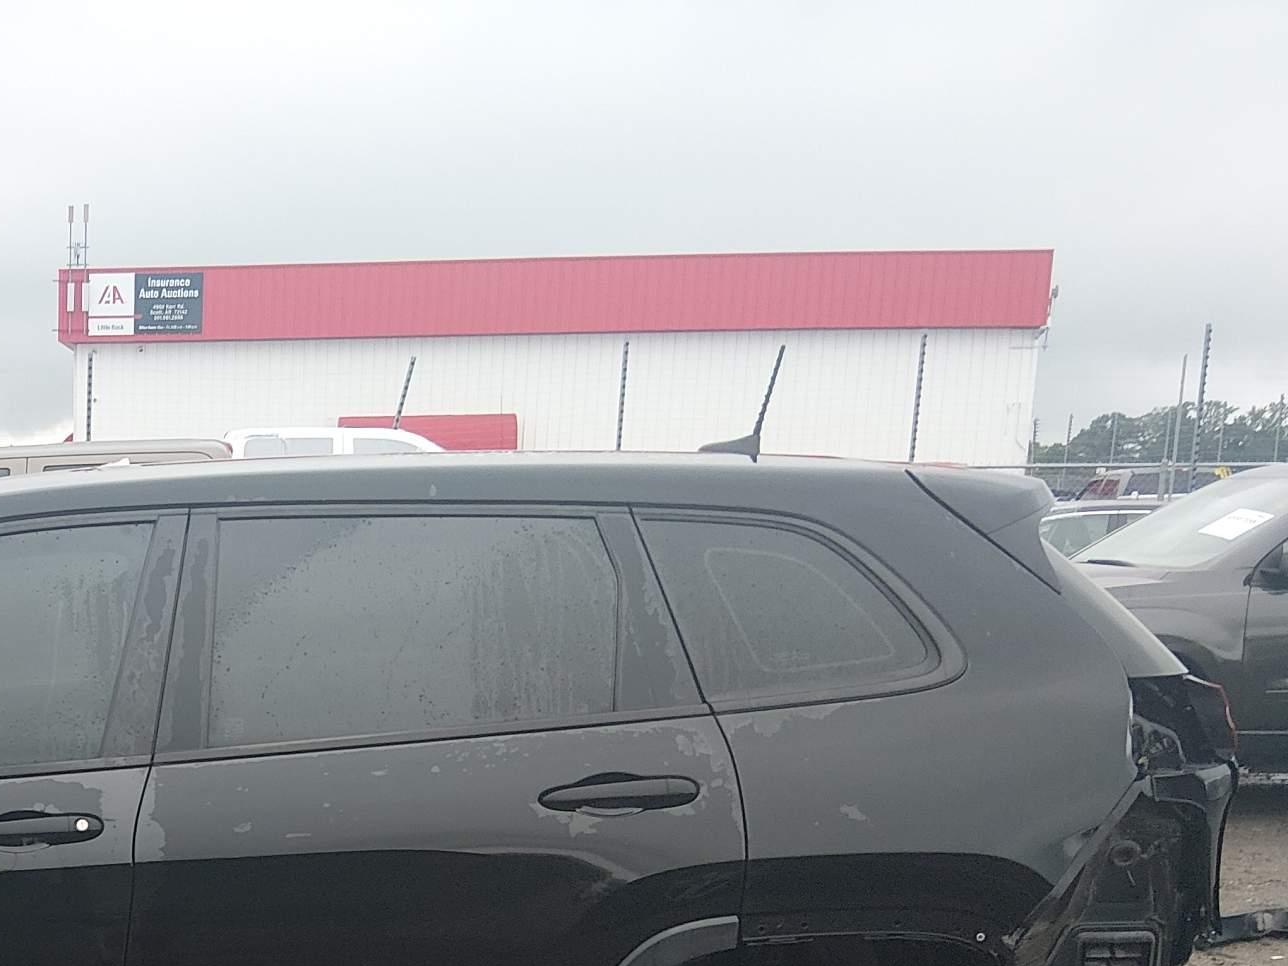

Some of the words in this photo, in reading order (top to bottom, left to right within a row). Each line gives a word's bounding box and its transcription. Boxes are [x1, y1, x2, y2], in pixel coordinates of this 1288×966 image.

[147, 276, 191, 287] Insurance
[138, 287, 159, 298] Auto
[160, 287, 199, 298] Auctions
